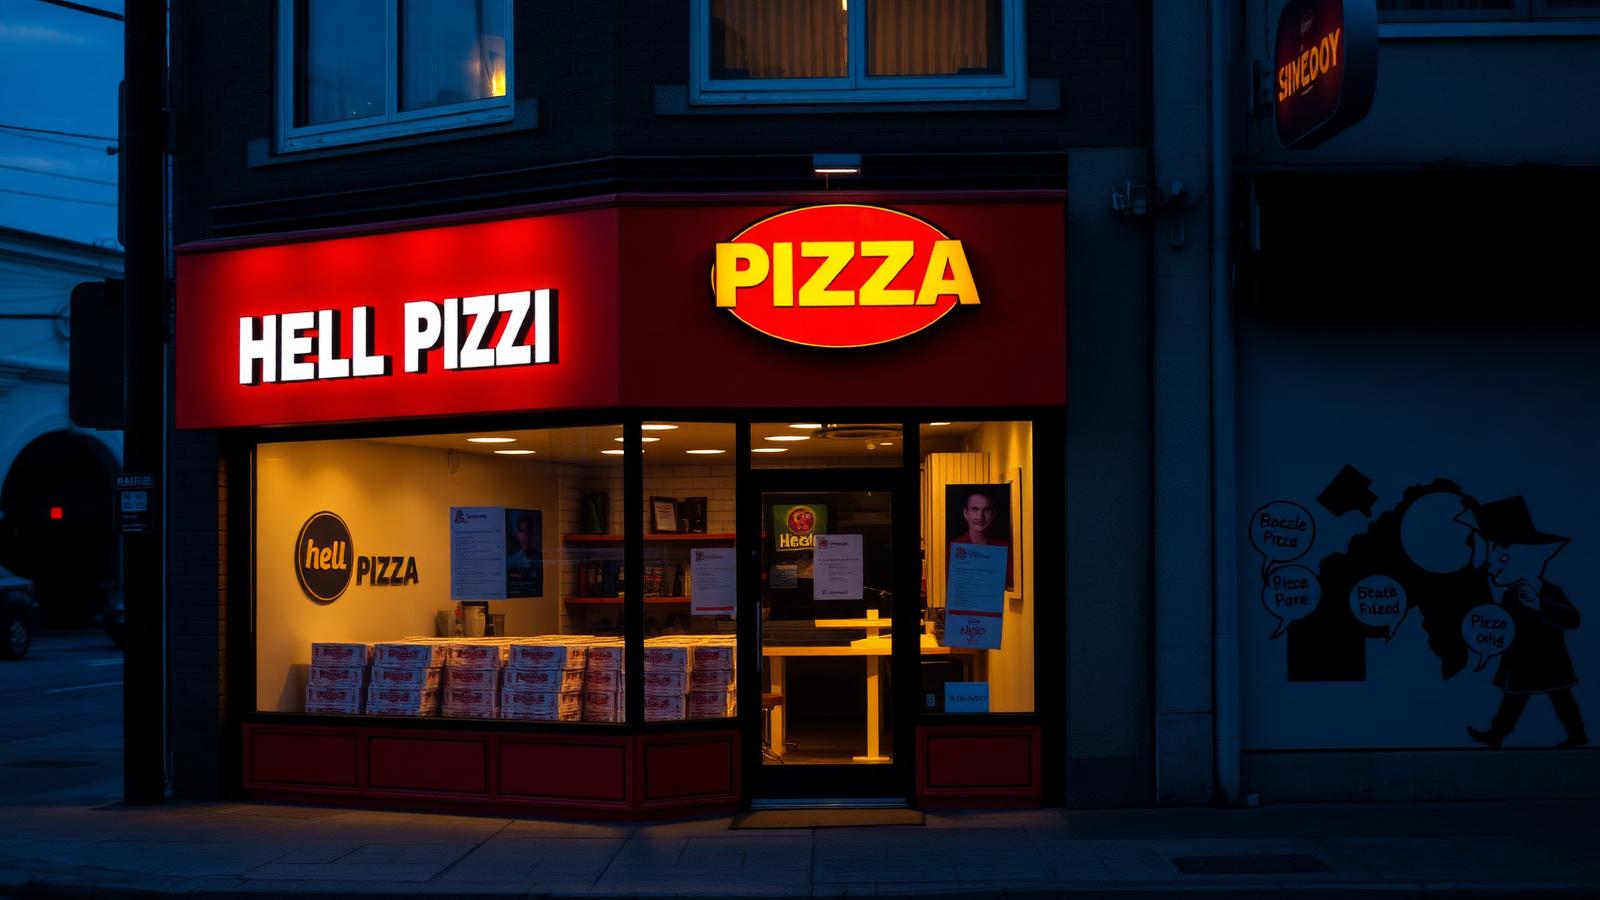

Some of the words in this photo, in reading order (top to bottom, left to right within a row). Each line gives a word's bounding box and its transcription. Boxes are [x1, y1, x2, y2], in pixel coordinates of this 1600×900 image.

[715, 240, 981, 307] PIZZA
[239, 306, 389, 385] HELL
[404, 288, 556, 373] PIZZI
[305, 538, 347, 570] hell
[356, 555, 419, 586] PIZZA
